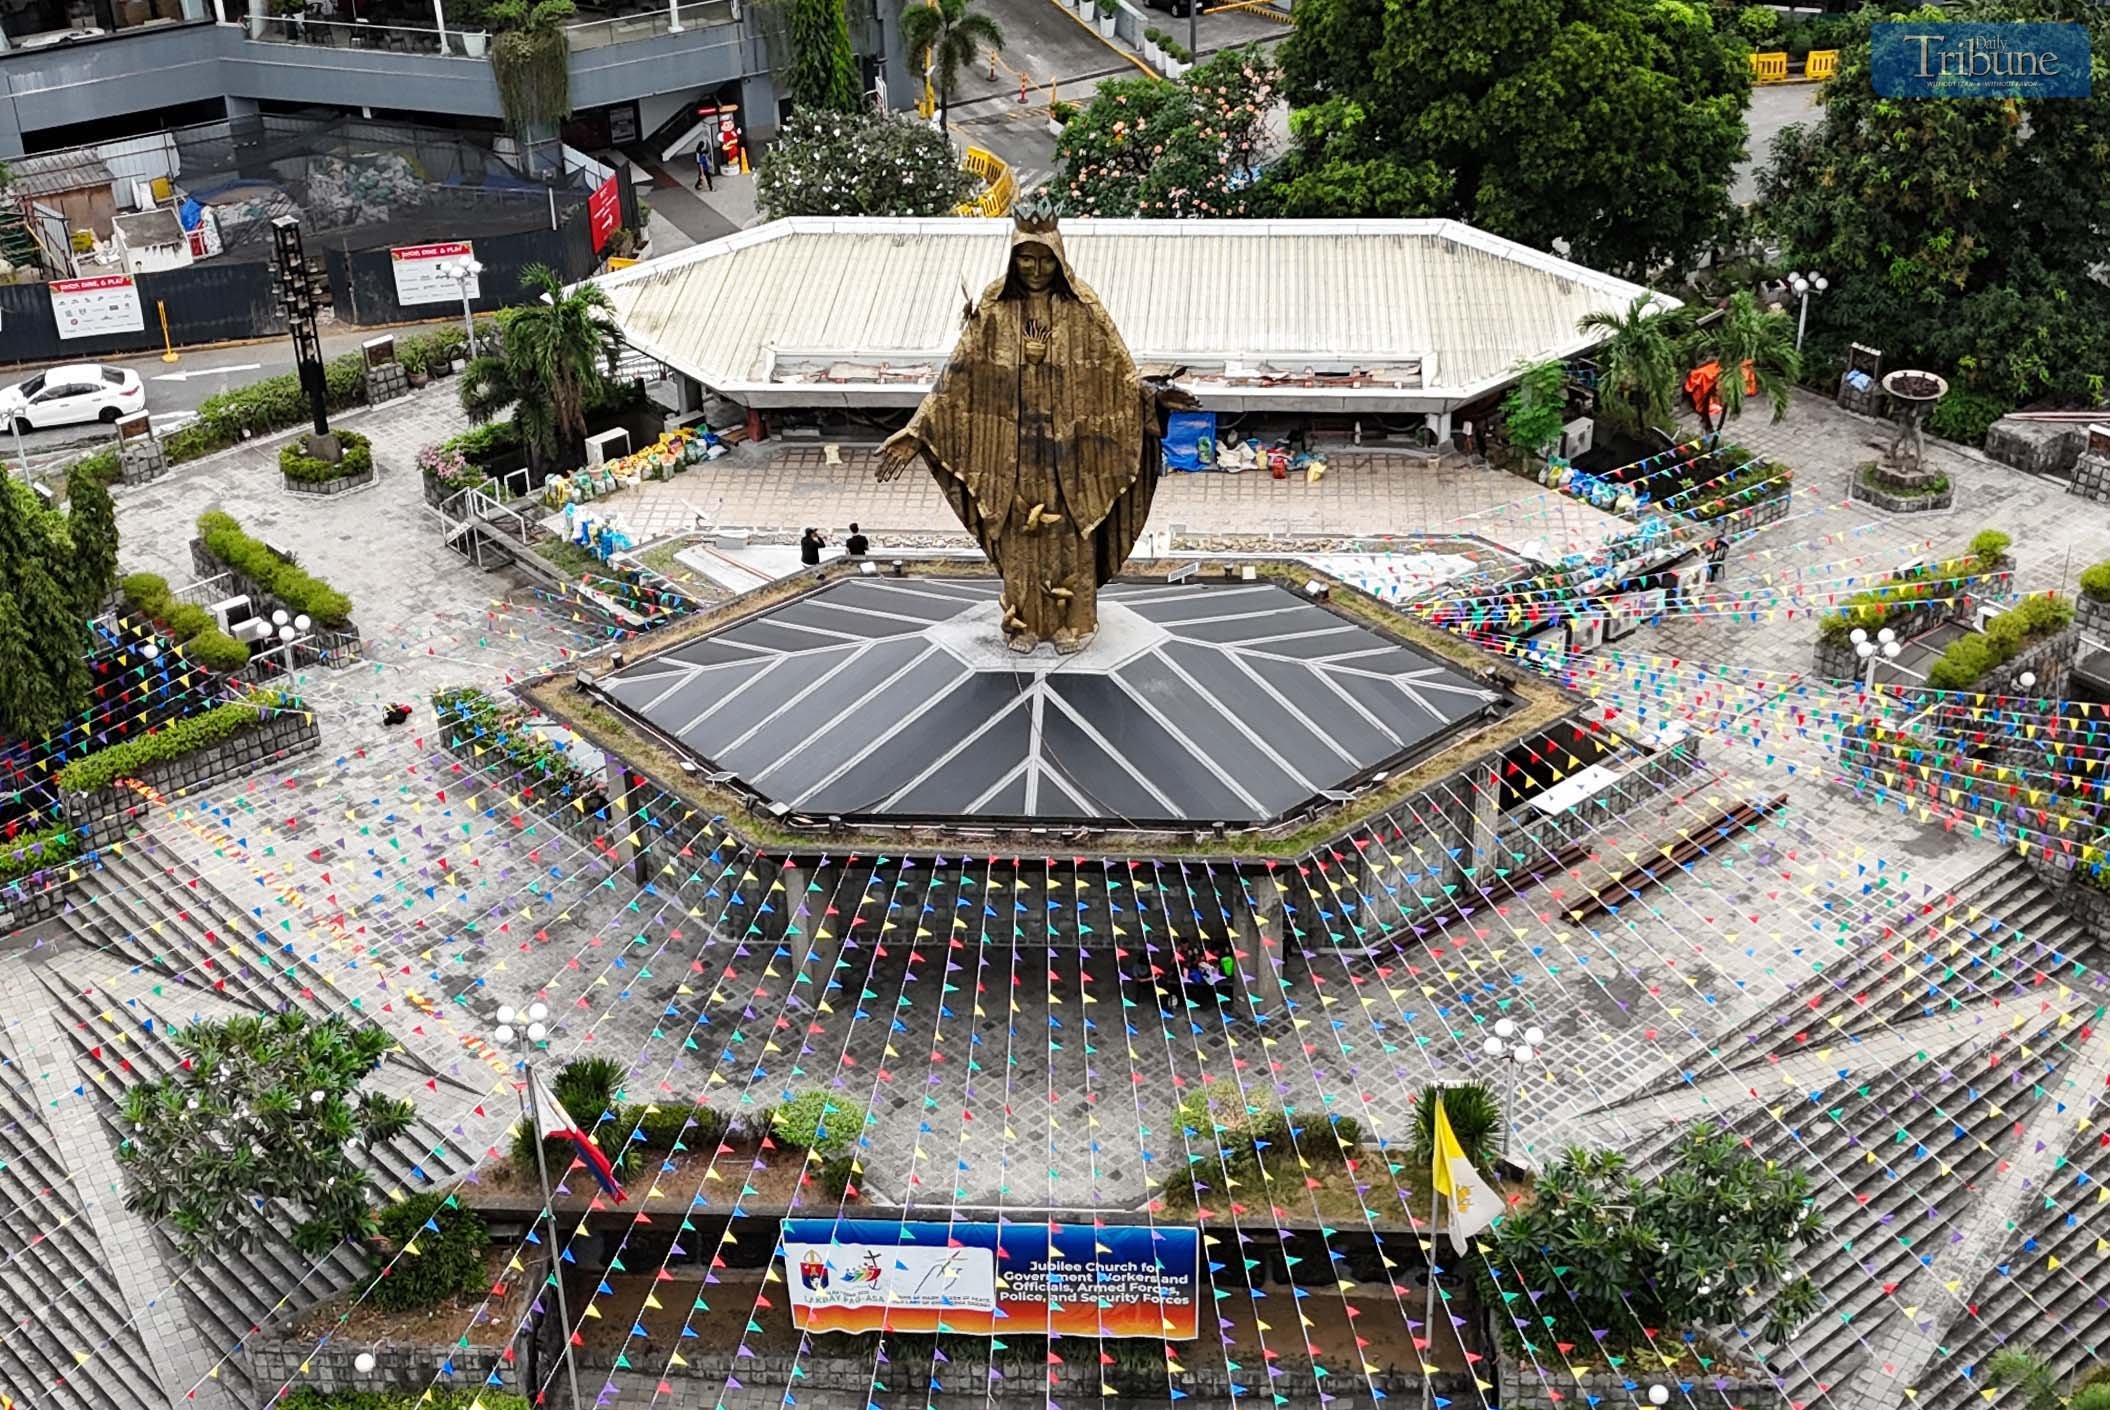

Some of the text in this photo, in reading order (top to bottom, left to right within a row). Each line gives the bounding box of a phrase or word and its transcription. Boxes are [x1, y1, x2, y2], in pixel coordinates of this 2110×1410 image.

[1030, 1261, 1160, 1273] Jubilee Church fo
[1004, 1271, 1093, 1283] Goverment
[1161, 1274, 1189, 1285] and
[1012, 1281, 1074, 1293] Officials,
[1077, 1281, 1126, 1293] Armed
[1000, 1291, 1047, 1303] Police,
[1050, 1291, 1077, 1303] and
